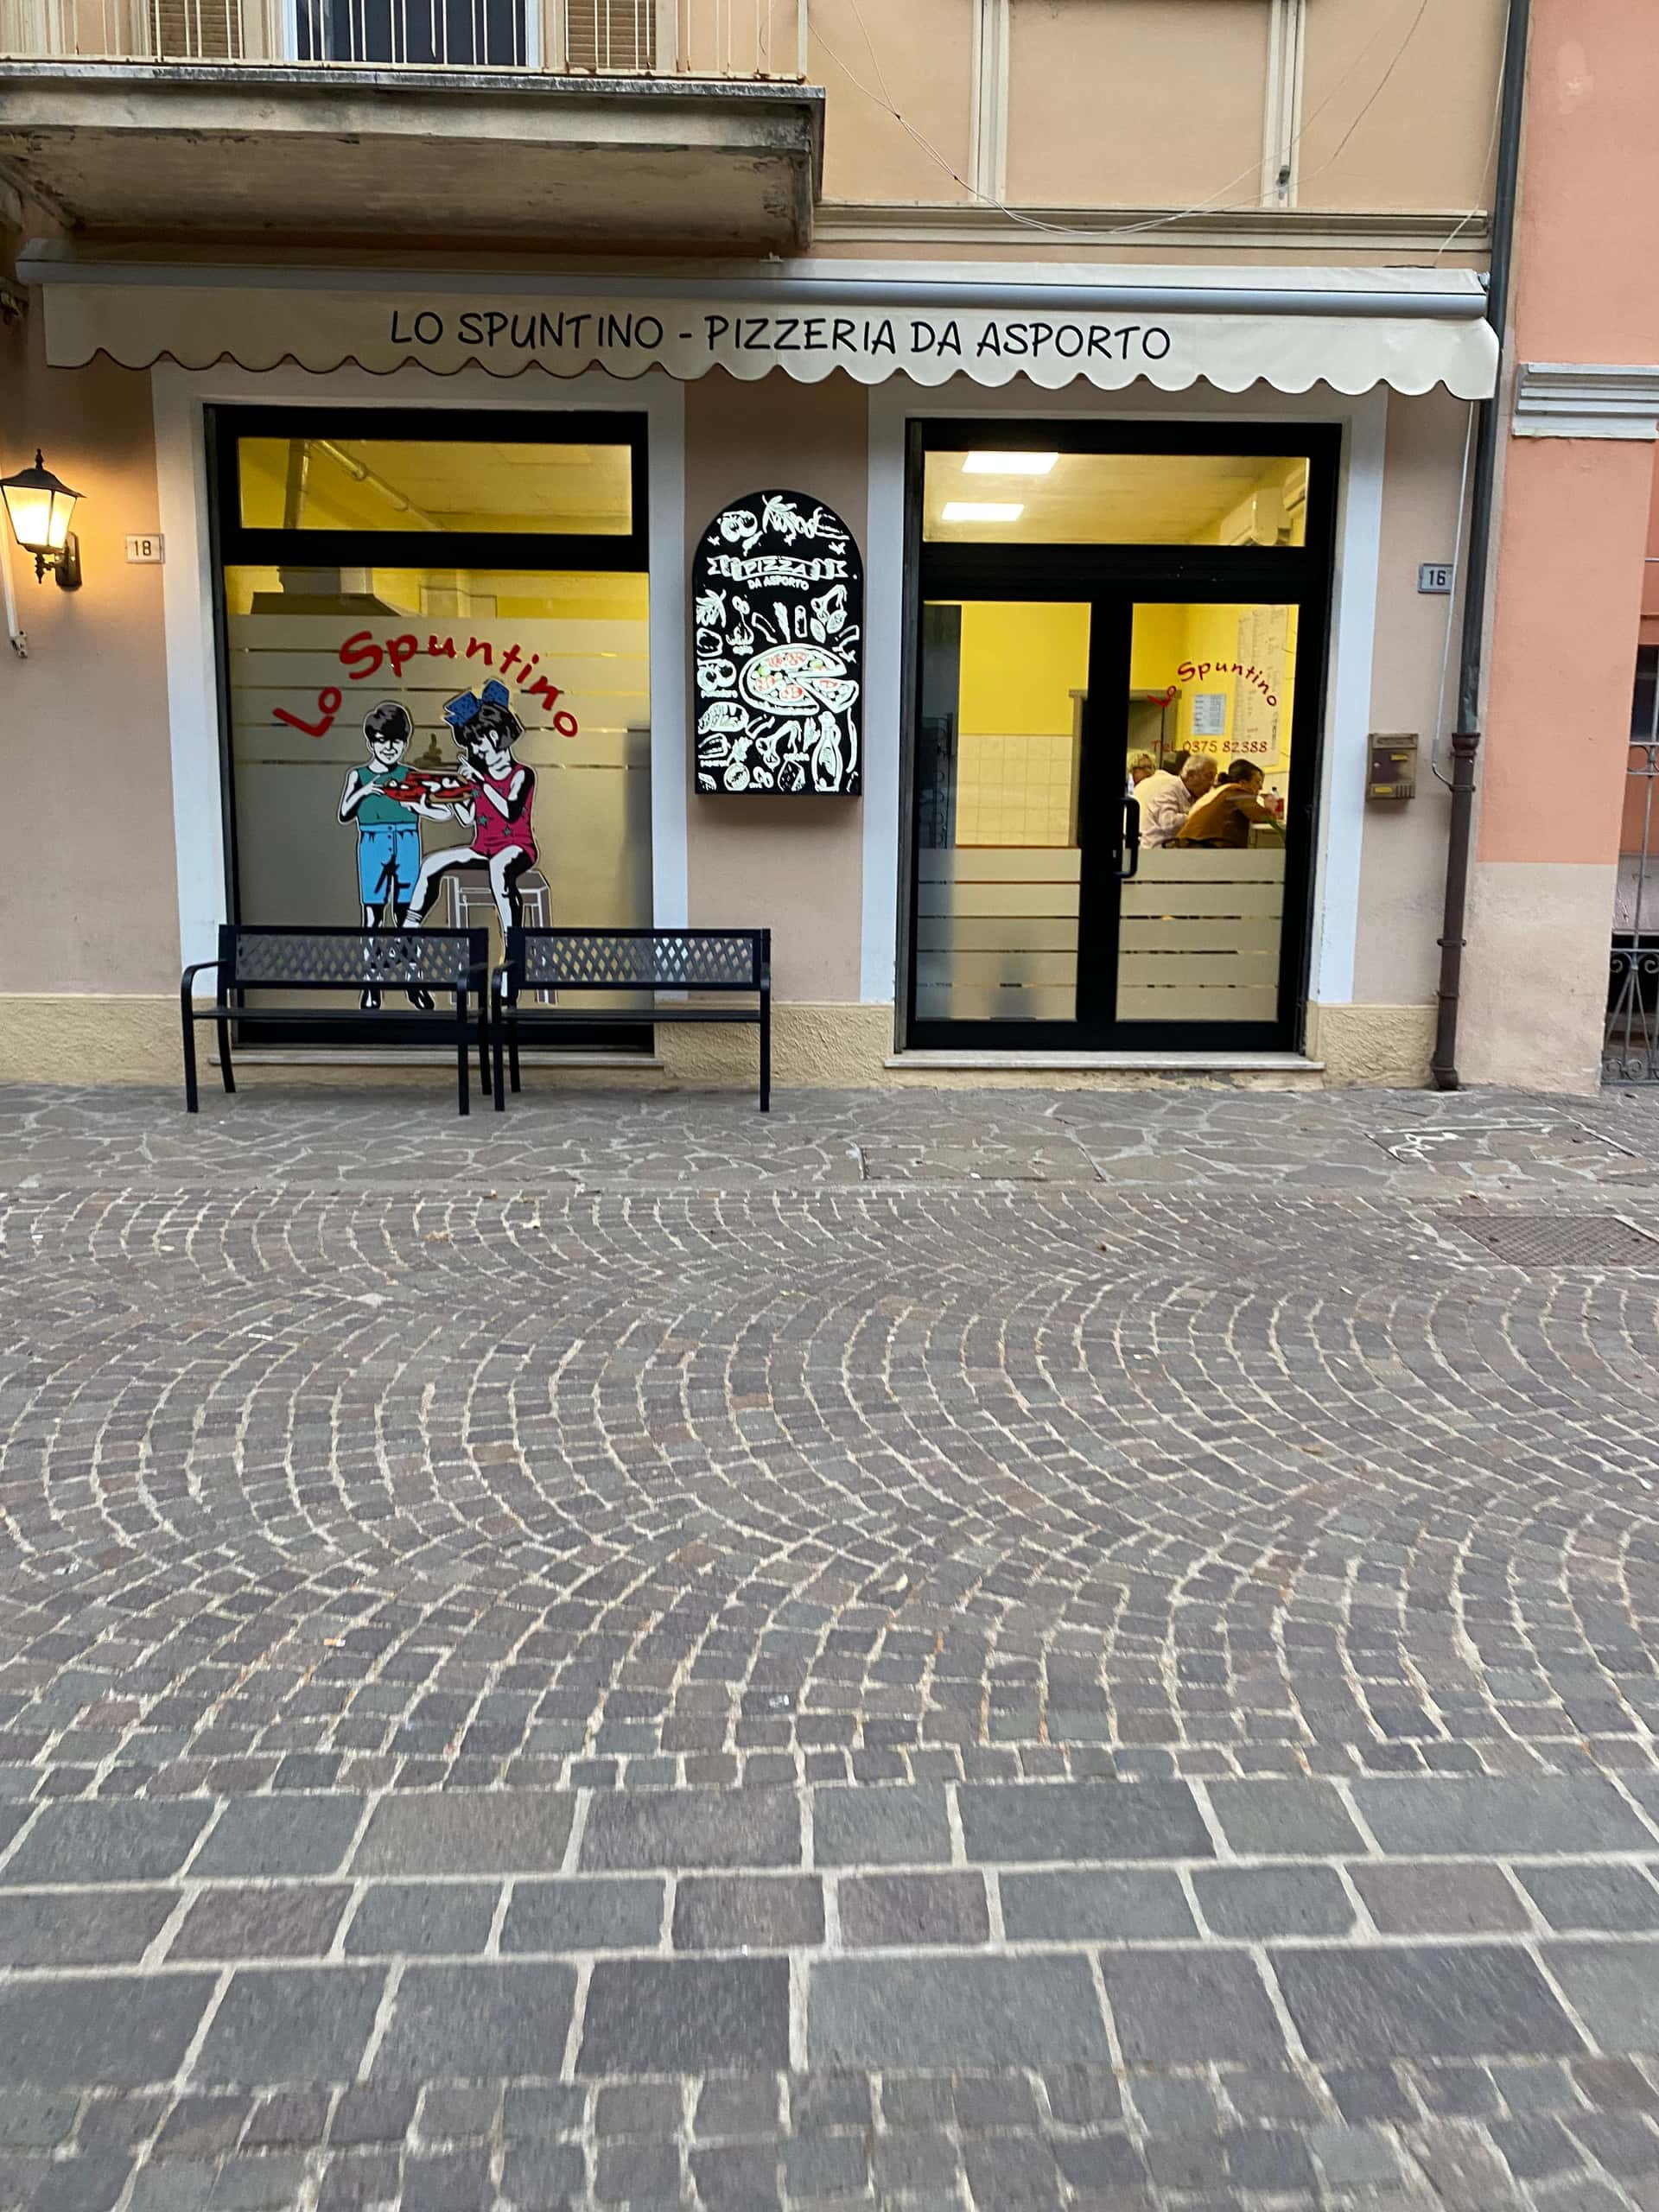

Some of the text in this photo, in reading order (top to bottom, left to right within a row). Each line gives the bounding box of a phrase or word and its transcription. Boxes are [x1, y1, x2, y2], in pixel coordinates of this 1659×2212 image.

[391, 310, 443, 345] LO
[457, 312, 664, 349] SPUNTINO
[704, 315, 896, 355] PIZZERIA
[910, 321, 963, 356] DA
[976, 321, 1171, 360] ASPORTO
[134, 540, 152, 556] 18
[745, 559, 808, 575] PIZZA
[747, 575, 810, 590] DA ASPORTO
[1428, 569, 1446, 587] 16
[272, 630, 579, 738] Lo Spuntino
[1147, 661, 1277, 708] Lo Spuntino
[1182, 740, 1217, 753] 0375
[1222, 741, 1268, 753] 82388
